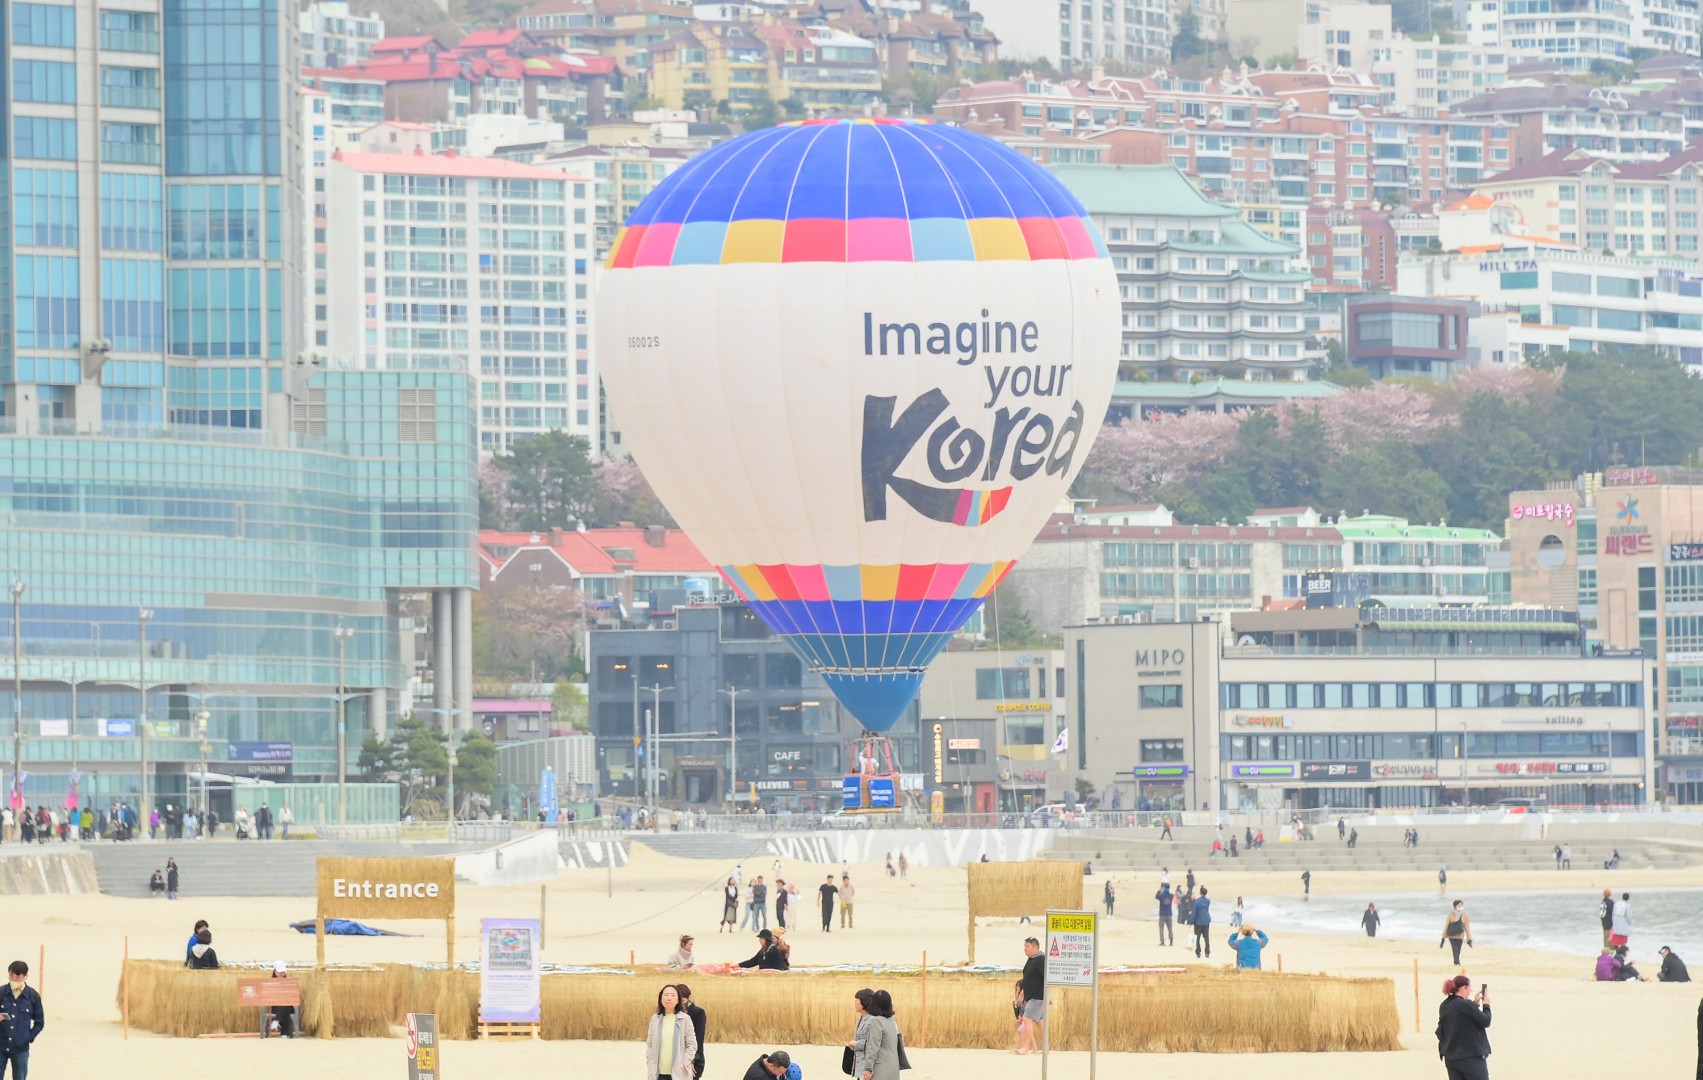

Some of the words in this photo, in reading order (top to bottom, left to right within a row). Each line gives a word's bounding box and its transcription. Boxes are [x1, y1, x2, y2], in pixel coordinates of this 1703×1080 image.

[1480, 261, 1510, 272] HILL
[1515, 260, 1538, 271] SPA
[864, 308, 1039, 366] Imagine
[984, 363, 1073, 409] your
[861, 387, 1085, 527] Korea
[1525, 503, 1575, 521] 미포칼국수
[1604, 534, 1654, 556] 씨랜드
[1308, 579, 1332, 591] BEER
[1135, 648, 1185, 667] MIPO
[774, 751, 801, 761] CAFE
[333, 878, 440, 899] Entrance
